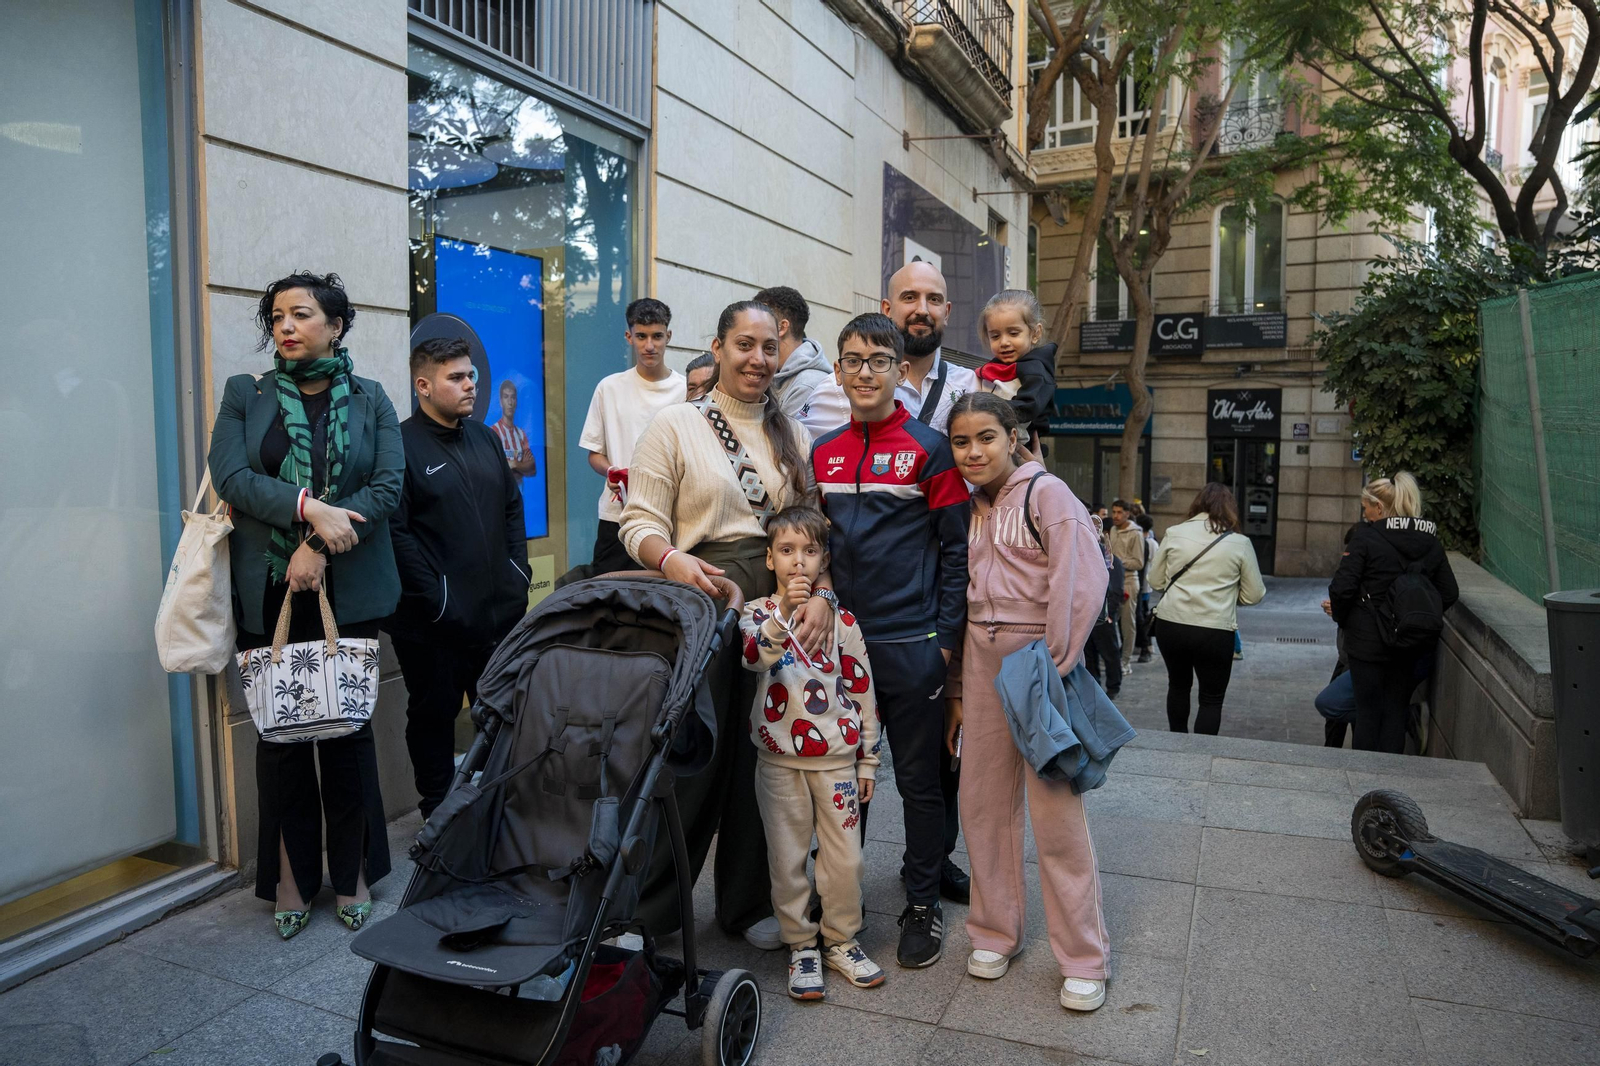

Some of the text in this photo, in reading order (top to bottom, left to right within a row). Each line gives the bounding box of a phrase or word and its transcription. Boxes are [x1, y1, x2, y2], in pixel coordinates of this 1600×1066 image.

[1157, 317, 1199, 340] C&G
[1246, 400, 1274, 420] Hair
[828, 456, 845, 465] ALEX
[994, 506, 1042, 549] YOR
[1386, 517, 1410, 530] NEW
[529, 580, 551, 593] gustan
